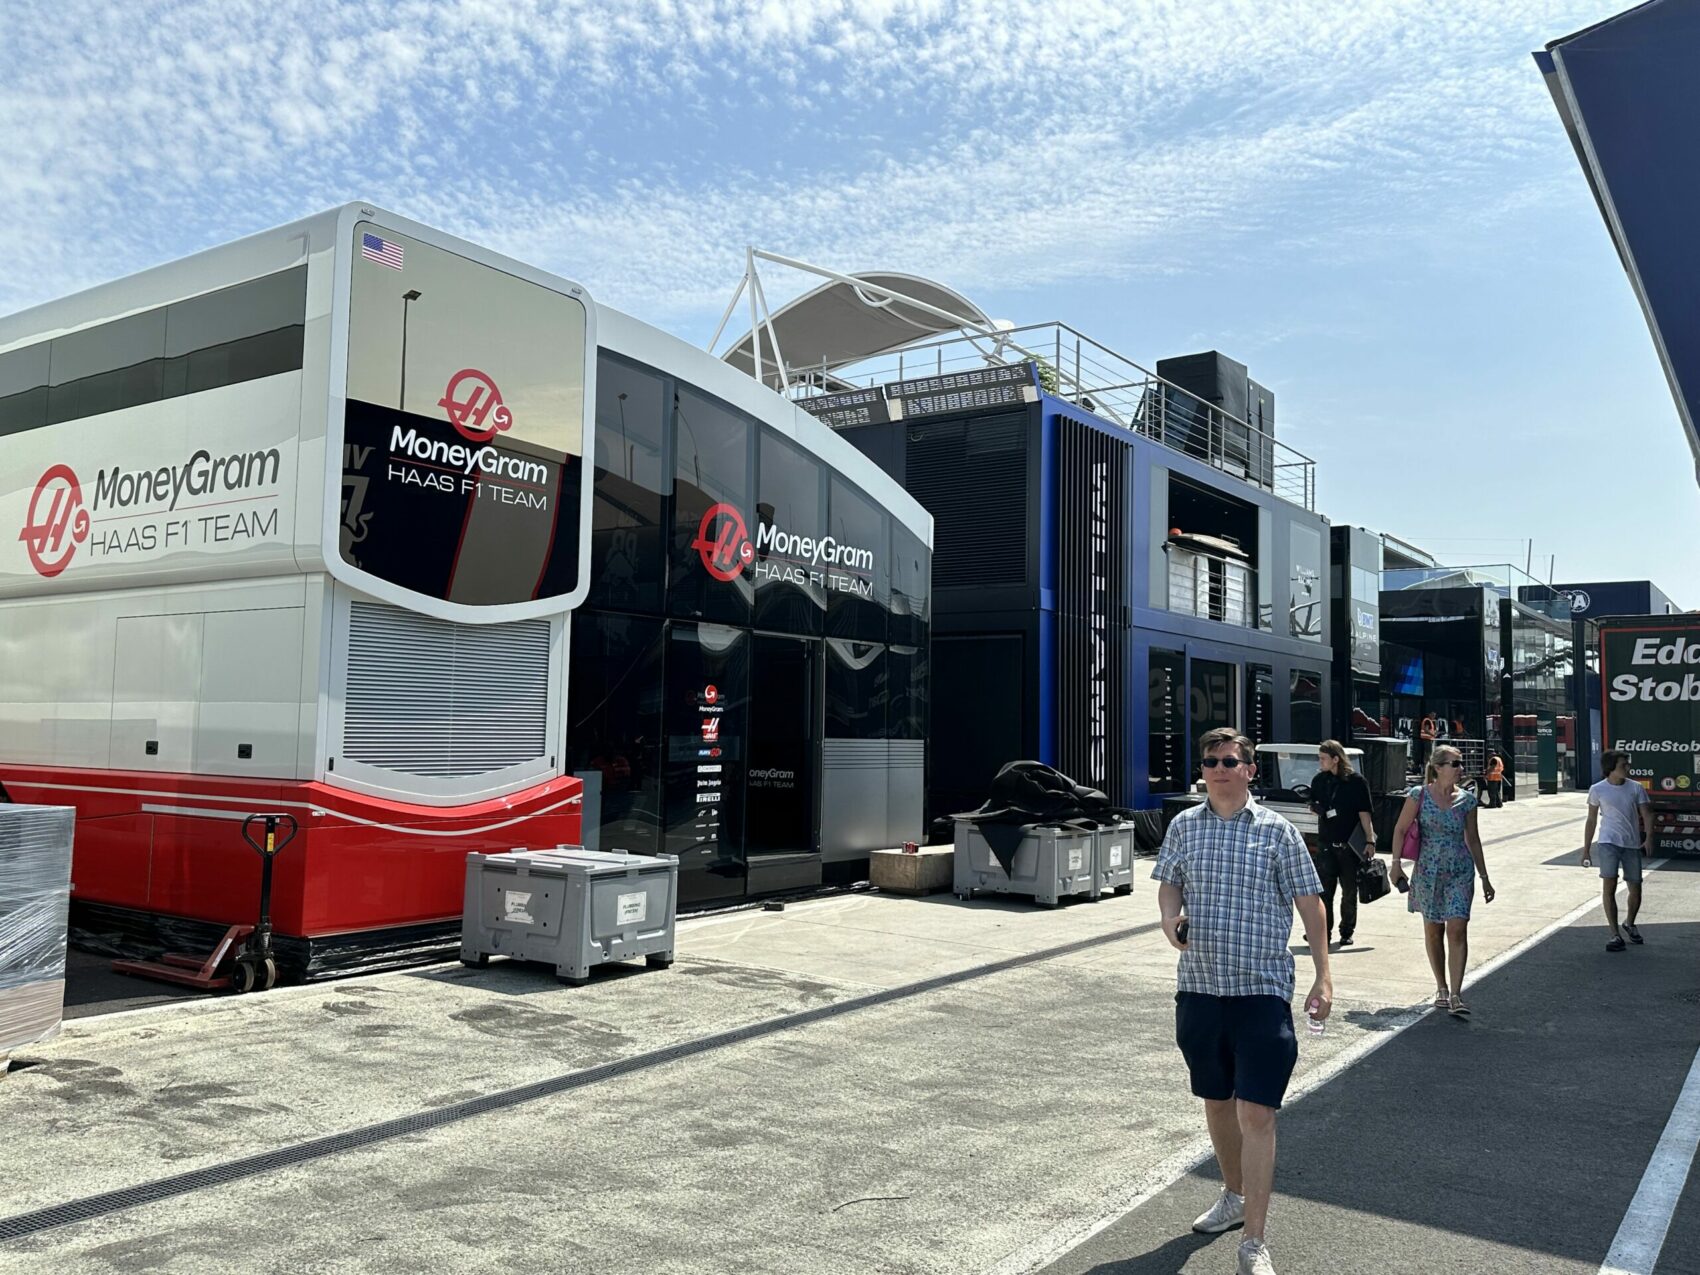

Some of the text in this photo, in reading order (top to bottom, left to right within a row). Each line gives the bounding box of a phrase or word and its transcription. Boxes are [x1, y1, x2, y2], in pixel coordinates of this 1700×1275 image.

[390, 425, 548, 485] MoneyGram
[93, 448, 280, 512] MoneyGram
[388, 464, 547, 511] HAAS F1 TEAM
[90, 508, 278, 556] HAAS F1 TEAM
[756, 522, 873, 570] MoneyGram
[755, 562, 873, 597] HAAS F1 TEAM
[1091, 462, 1107, 783] WILLIAMS
[699, 705, 724, 713] MoneyGram
[1609, 673, 1700, 701] Stob
[1629, 768, 1654, 777] 0036
